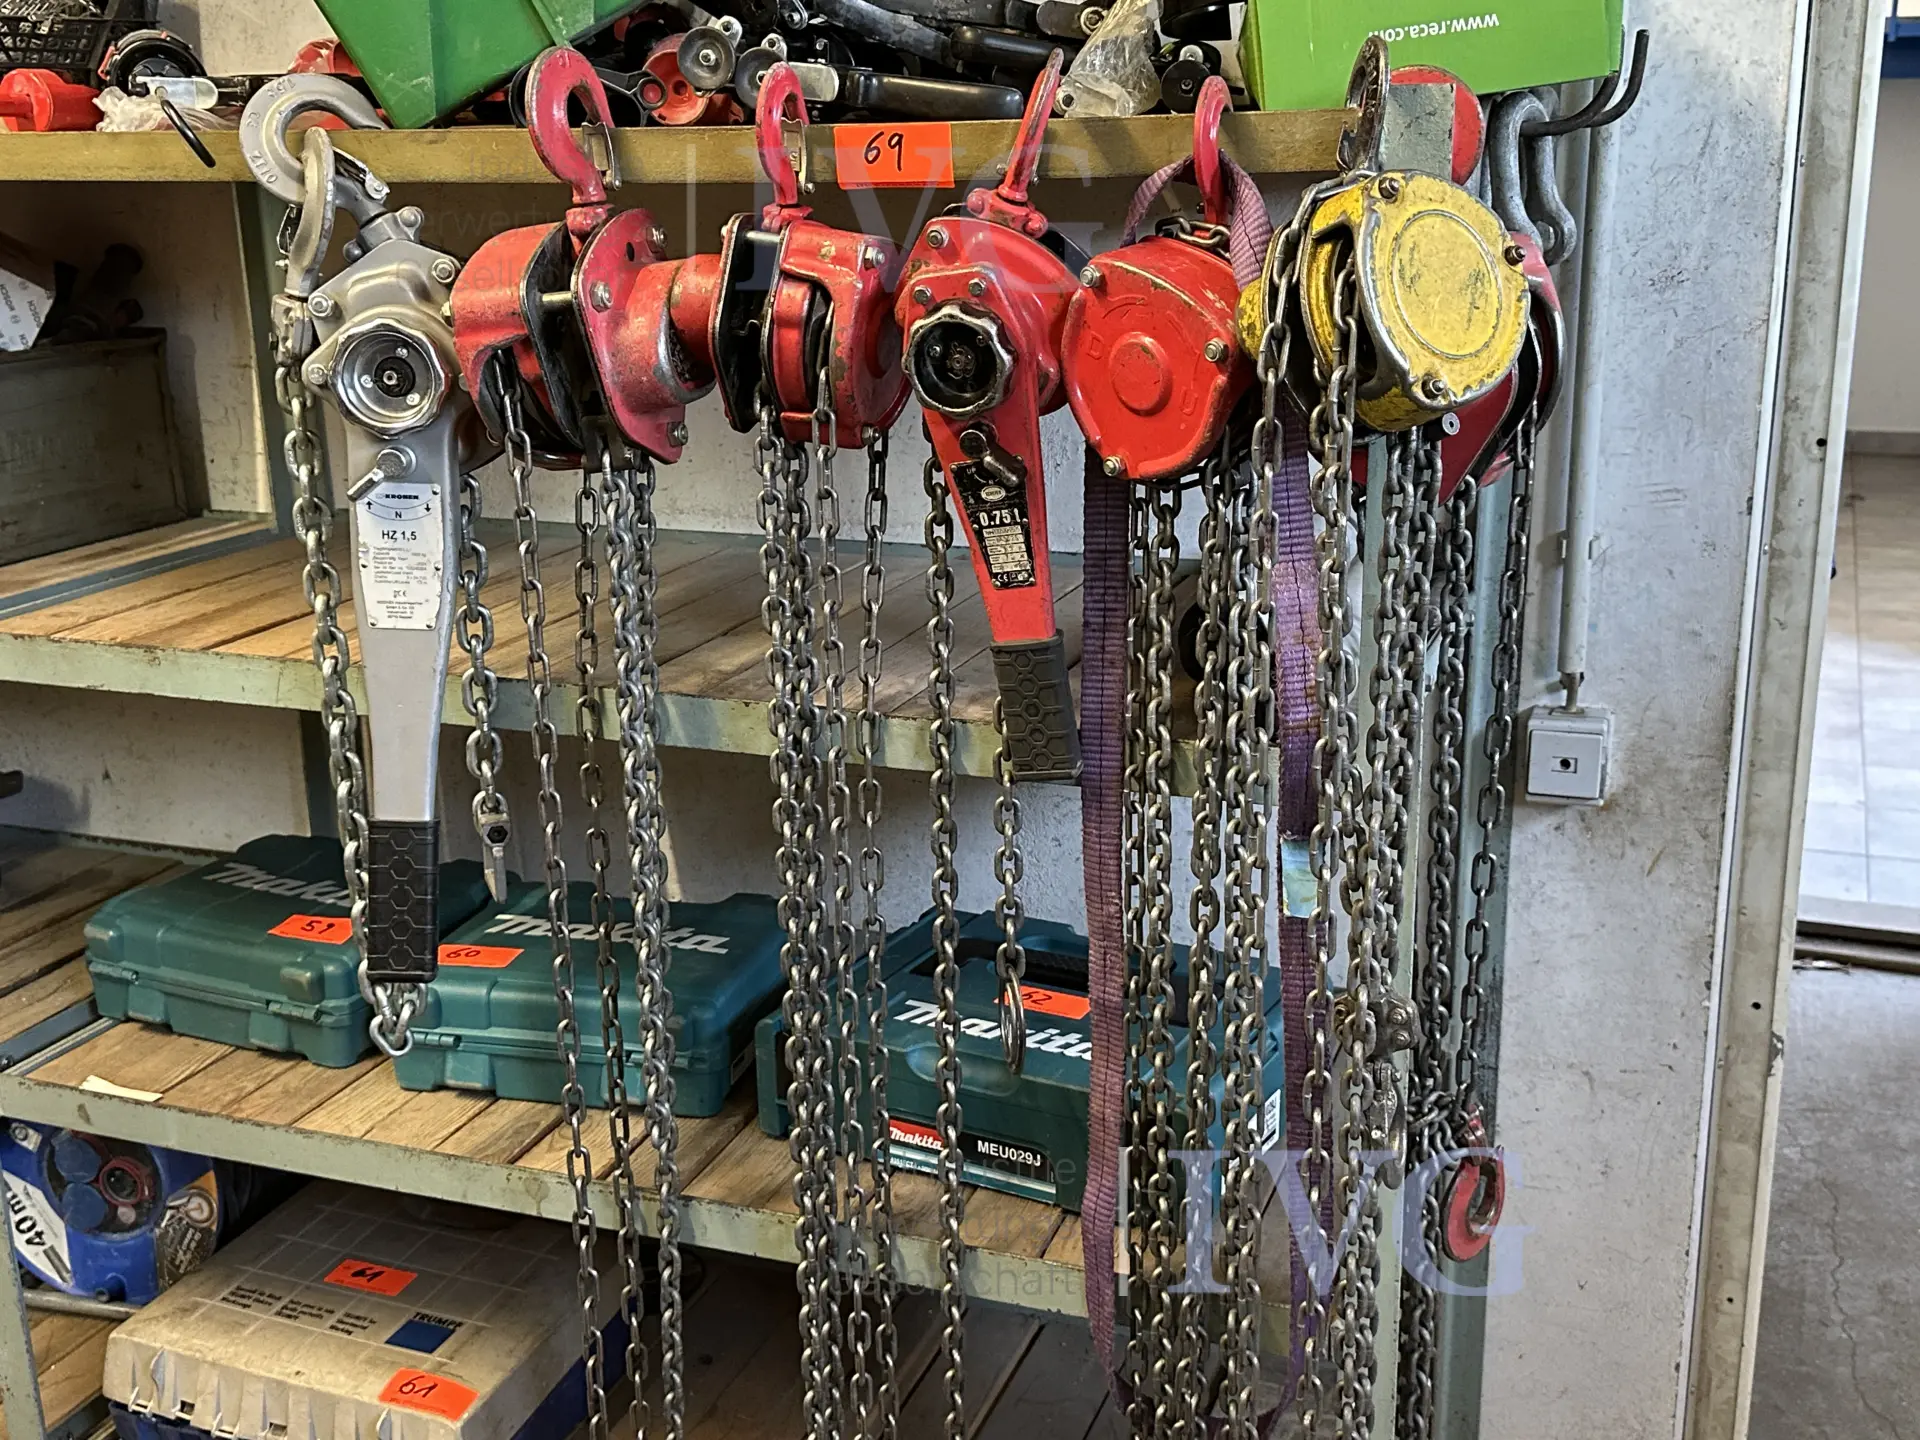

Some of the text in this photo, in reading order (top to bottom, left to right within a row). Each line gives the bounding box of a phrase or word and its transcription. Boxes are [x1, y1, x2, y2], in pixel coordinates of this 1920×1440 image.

[863, 131, 904, 172] 69
[395, 510, 402, 519] N
[979, 509, 1011, 527] 0.75
[381, 529, 418, 542] HZ 1,5
[977, 1140, 1041, 1167] MEU029J
[412, 1311, 464, 1329] TRUMPF
[398, 1374, 438, 1398] 61
